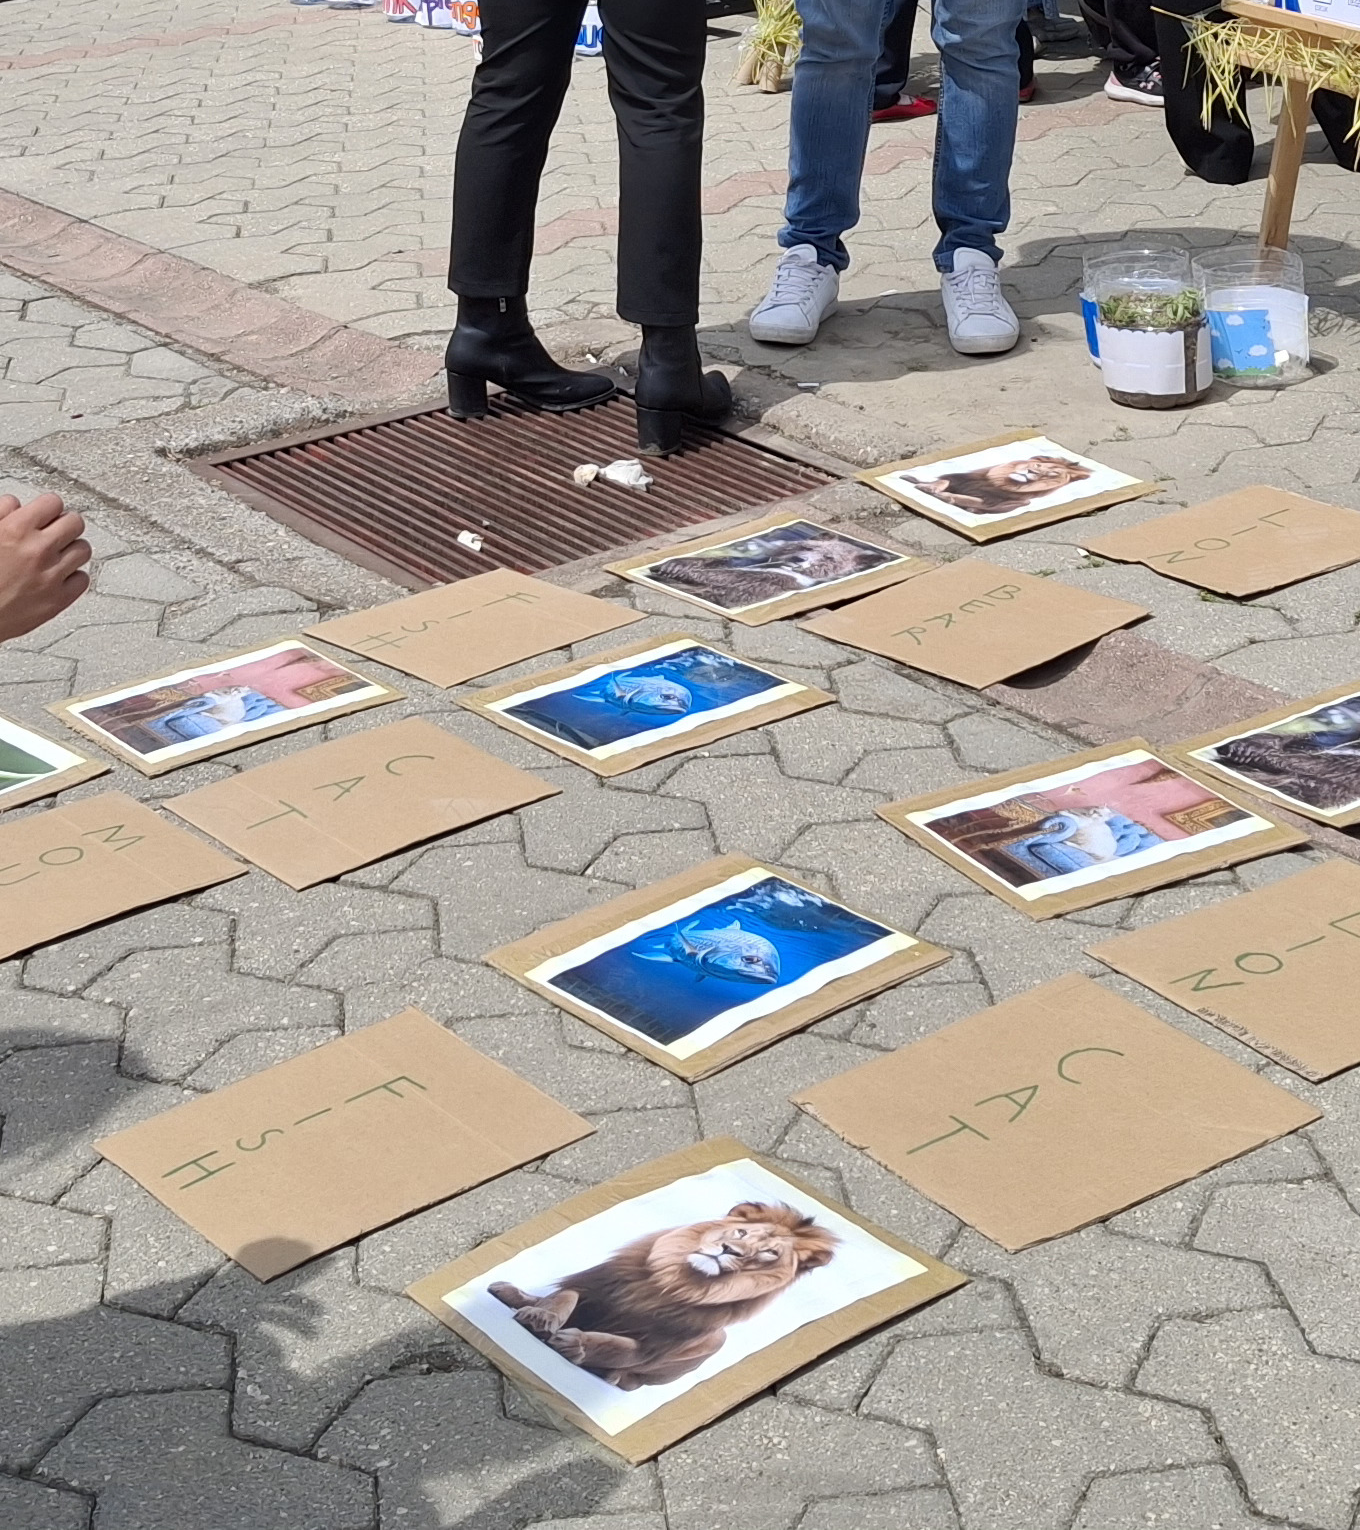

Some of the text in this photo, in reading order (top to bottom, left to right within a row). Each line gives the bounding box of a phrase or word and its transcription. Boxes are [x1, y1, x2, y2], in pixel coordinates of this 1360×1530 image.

[1150, 507, 1296, 569] LION
[350, 588, 540, 654] FISH
[245, 753, 436, 830] CAT
[160, 1073, 429, 1191] FISH
[905, 1046, 1127, 1157] CAT
